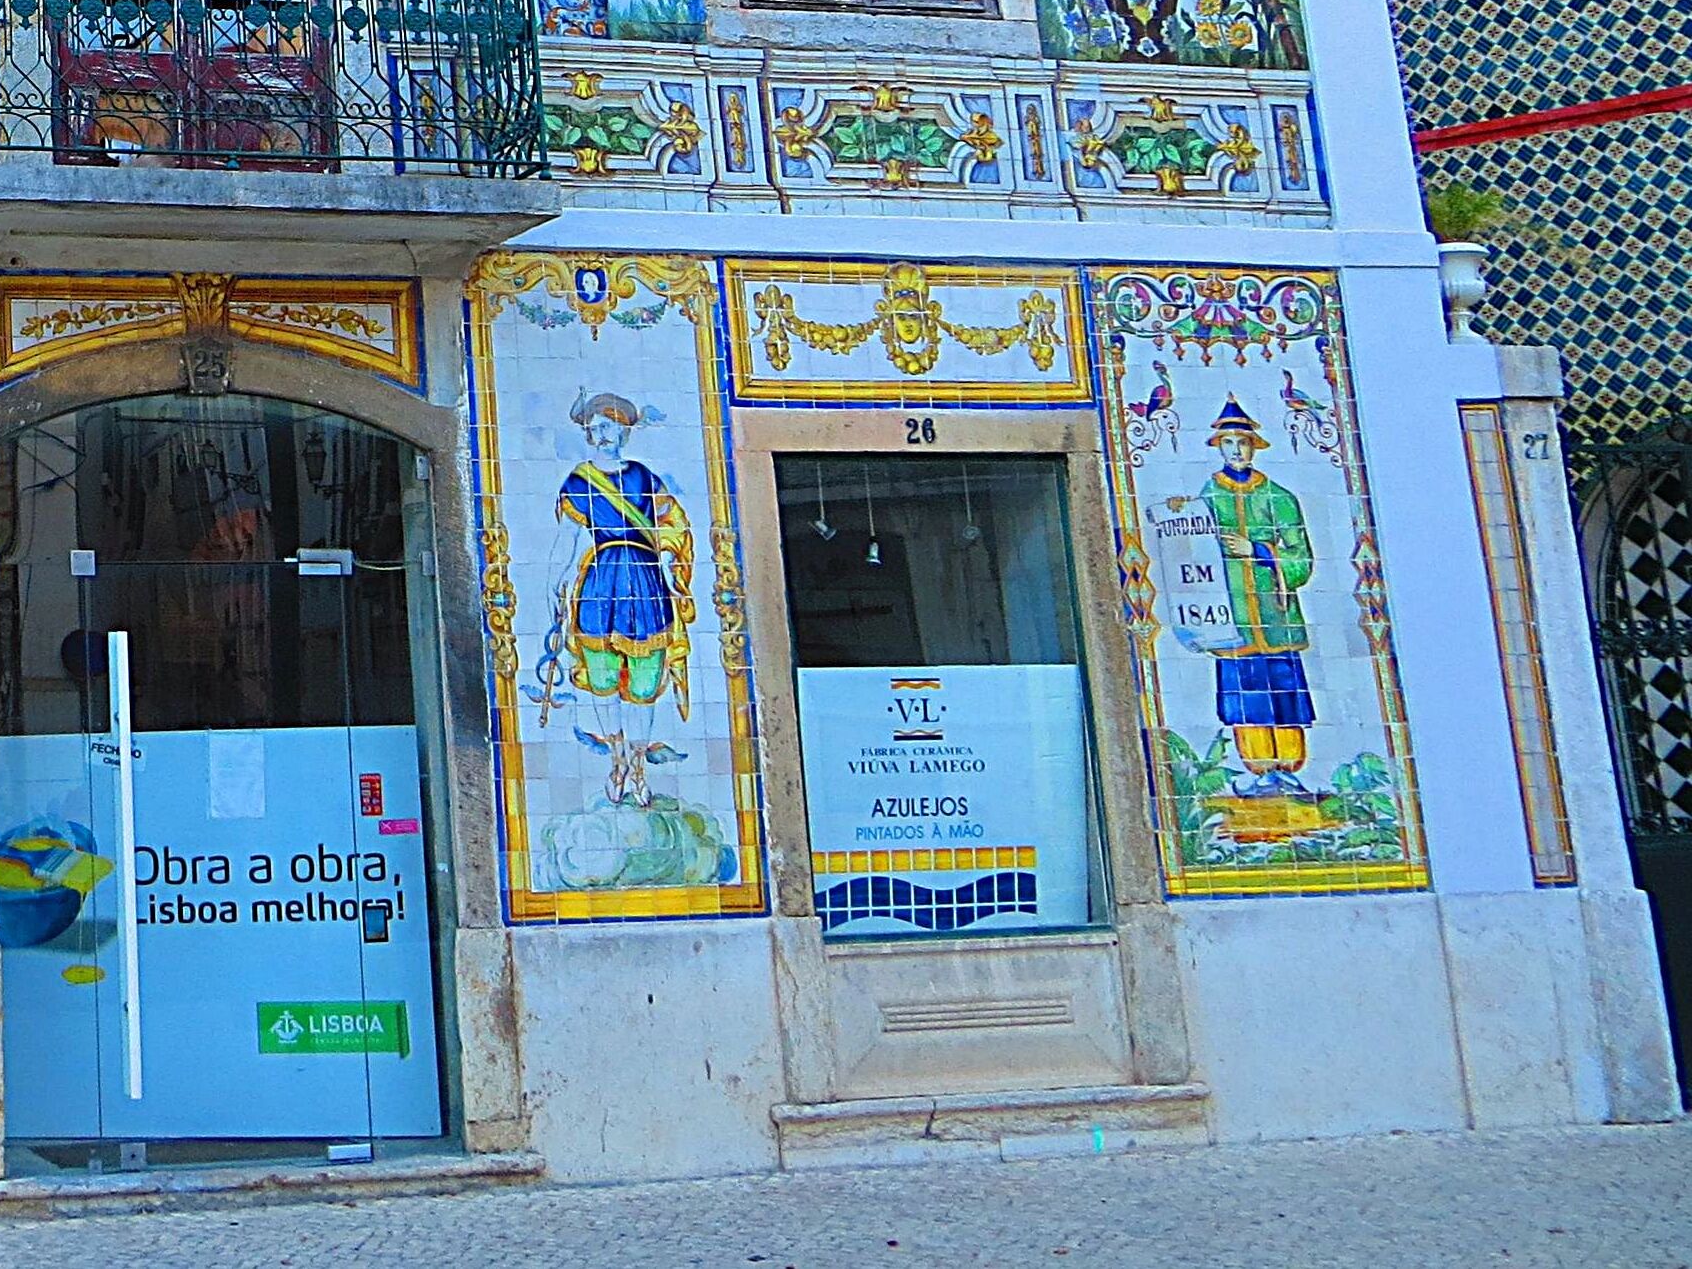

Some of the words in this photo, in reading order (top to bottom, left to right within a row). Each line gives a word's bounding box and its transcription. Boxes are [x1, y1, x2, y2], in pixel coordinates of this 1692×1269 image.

[195, 350, 226, 379] 25
[906, 418, 936, 444] 26
[1523, 434, 1550, 460] 27
[1181, 564, 1215, 584] EM
[1178, 604, 1232, 626] 1849
[91, 743, 141, 758] FECHO
[860, 746, 907, 758] FÁBRICA
[848, 756, 900, 775] VIÚVA
[910, 759, 986, 774] LAMEGO
[871, 796, 969, 818] AZULEJOS
[855, 825, 924, 841] PINTADOS
[949, 819, 984, 839] MÃO
[134, 846, 230, 885] Obra
[249, 854, 273, 884] a
[291, 843, 401, 887] obra,
[309, 1014, 384, 1033] LISBOA
